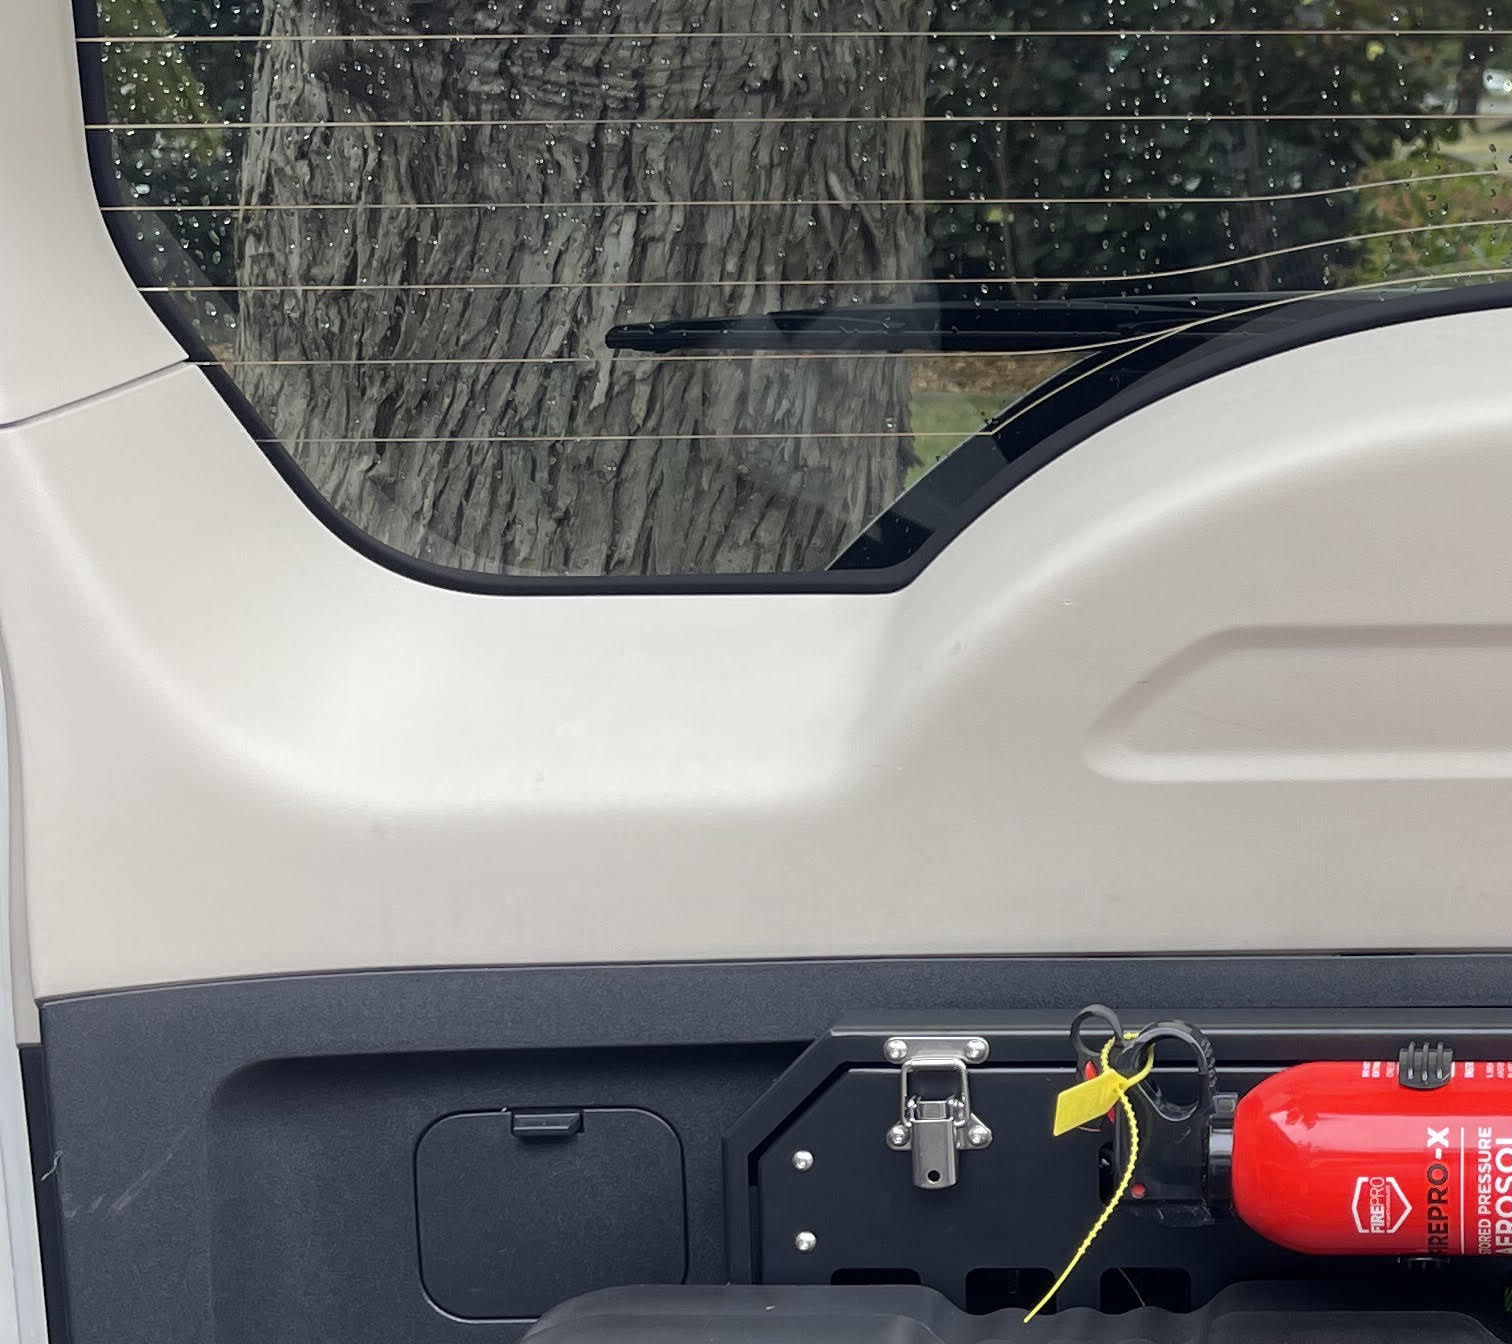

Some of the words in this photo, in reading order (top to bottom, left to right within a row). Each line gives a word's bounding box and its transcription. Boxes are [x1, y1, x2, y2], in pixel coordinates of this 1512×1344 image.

[1478, 1127, 1492, 1215] PRESSURE
[1370, 1177, 1385, 1233] FIREPRO
[1478, 1218, 1492, 1255] STORED
